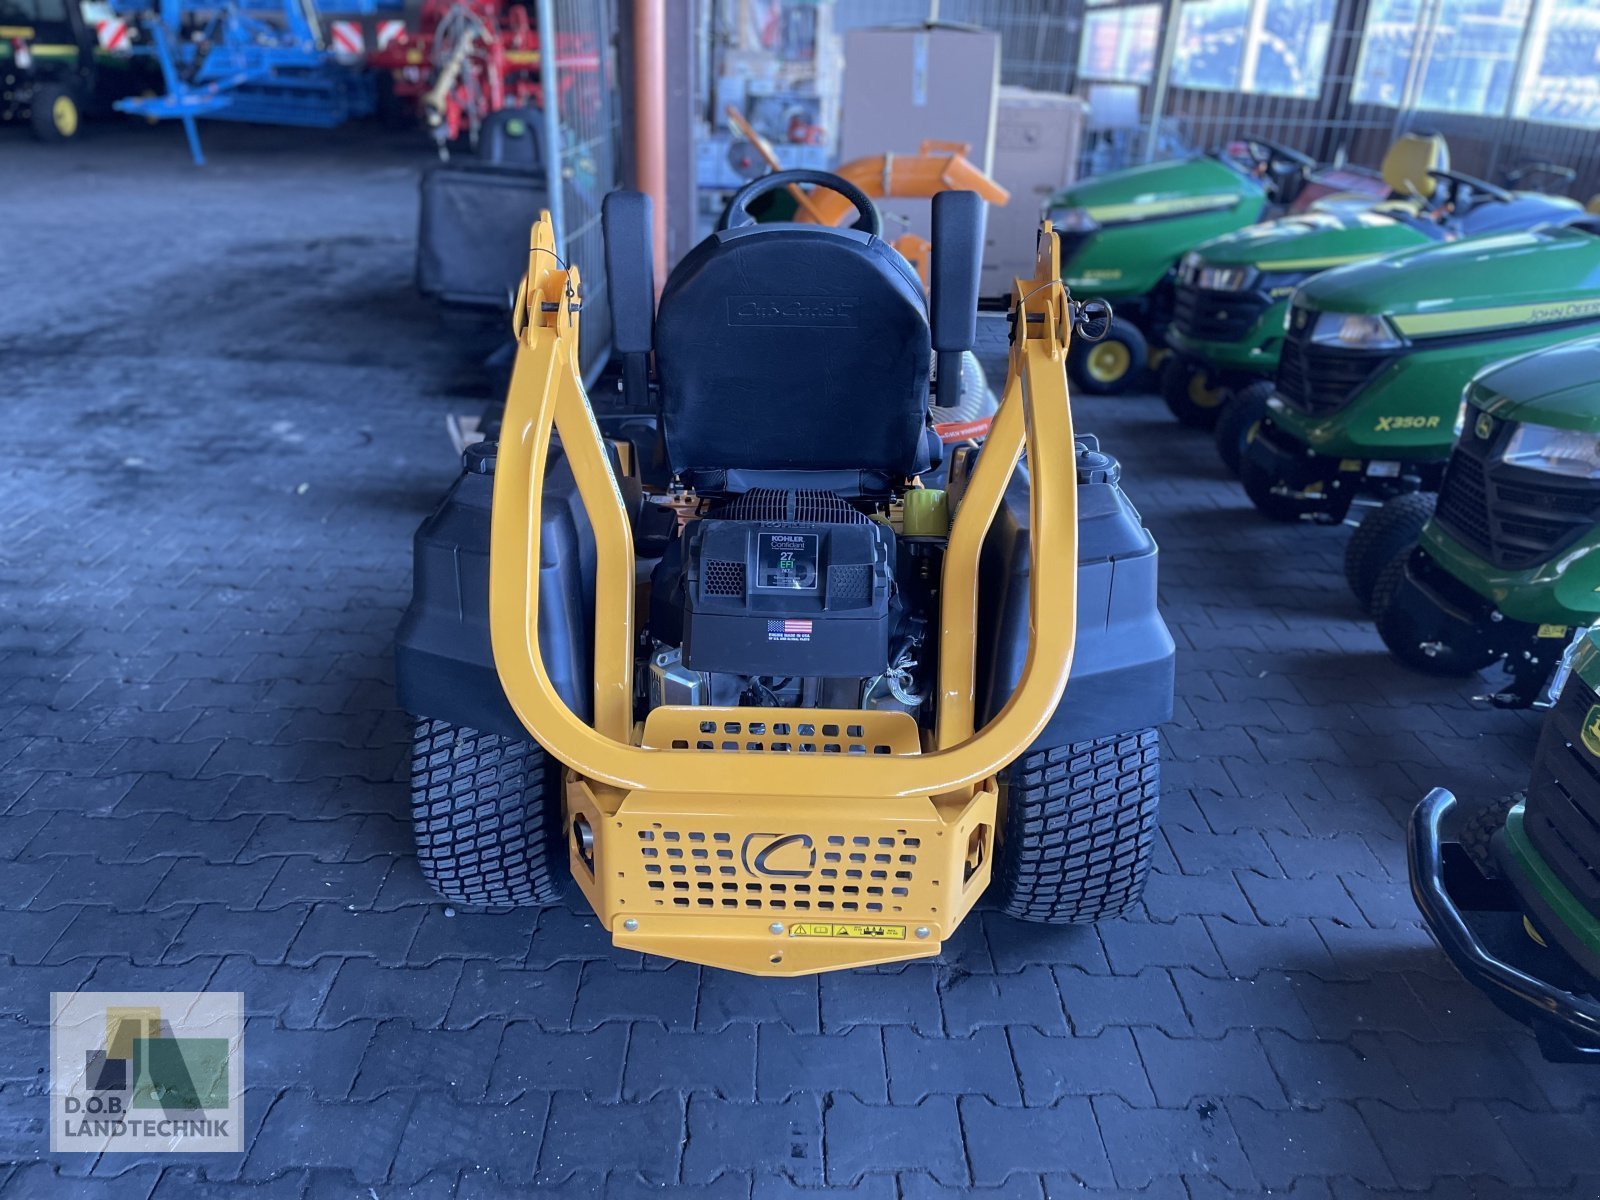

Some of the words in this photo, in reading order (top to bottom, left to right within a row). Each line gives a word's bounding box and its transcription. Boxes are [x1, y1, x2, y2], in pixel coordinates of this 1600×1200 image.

[1528, 307, 1565, 322] JOHN
[1566, 302, 1600, 319] DEER
[771, 535, 804, 543] KOHLER
[770, 541, 805, 549] Confidant
[780, 551, 794, 561] 27
[780, 560, 794, 569] EFI
